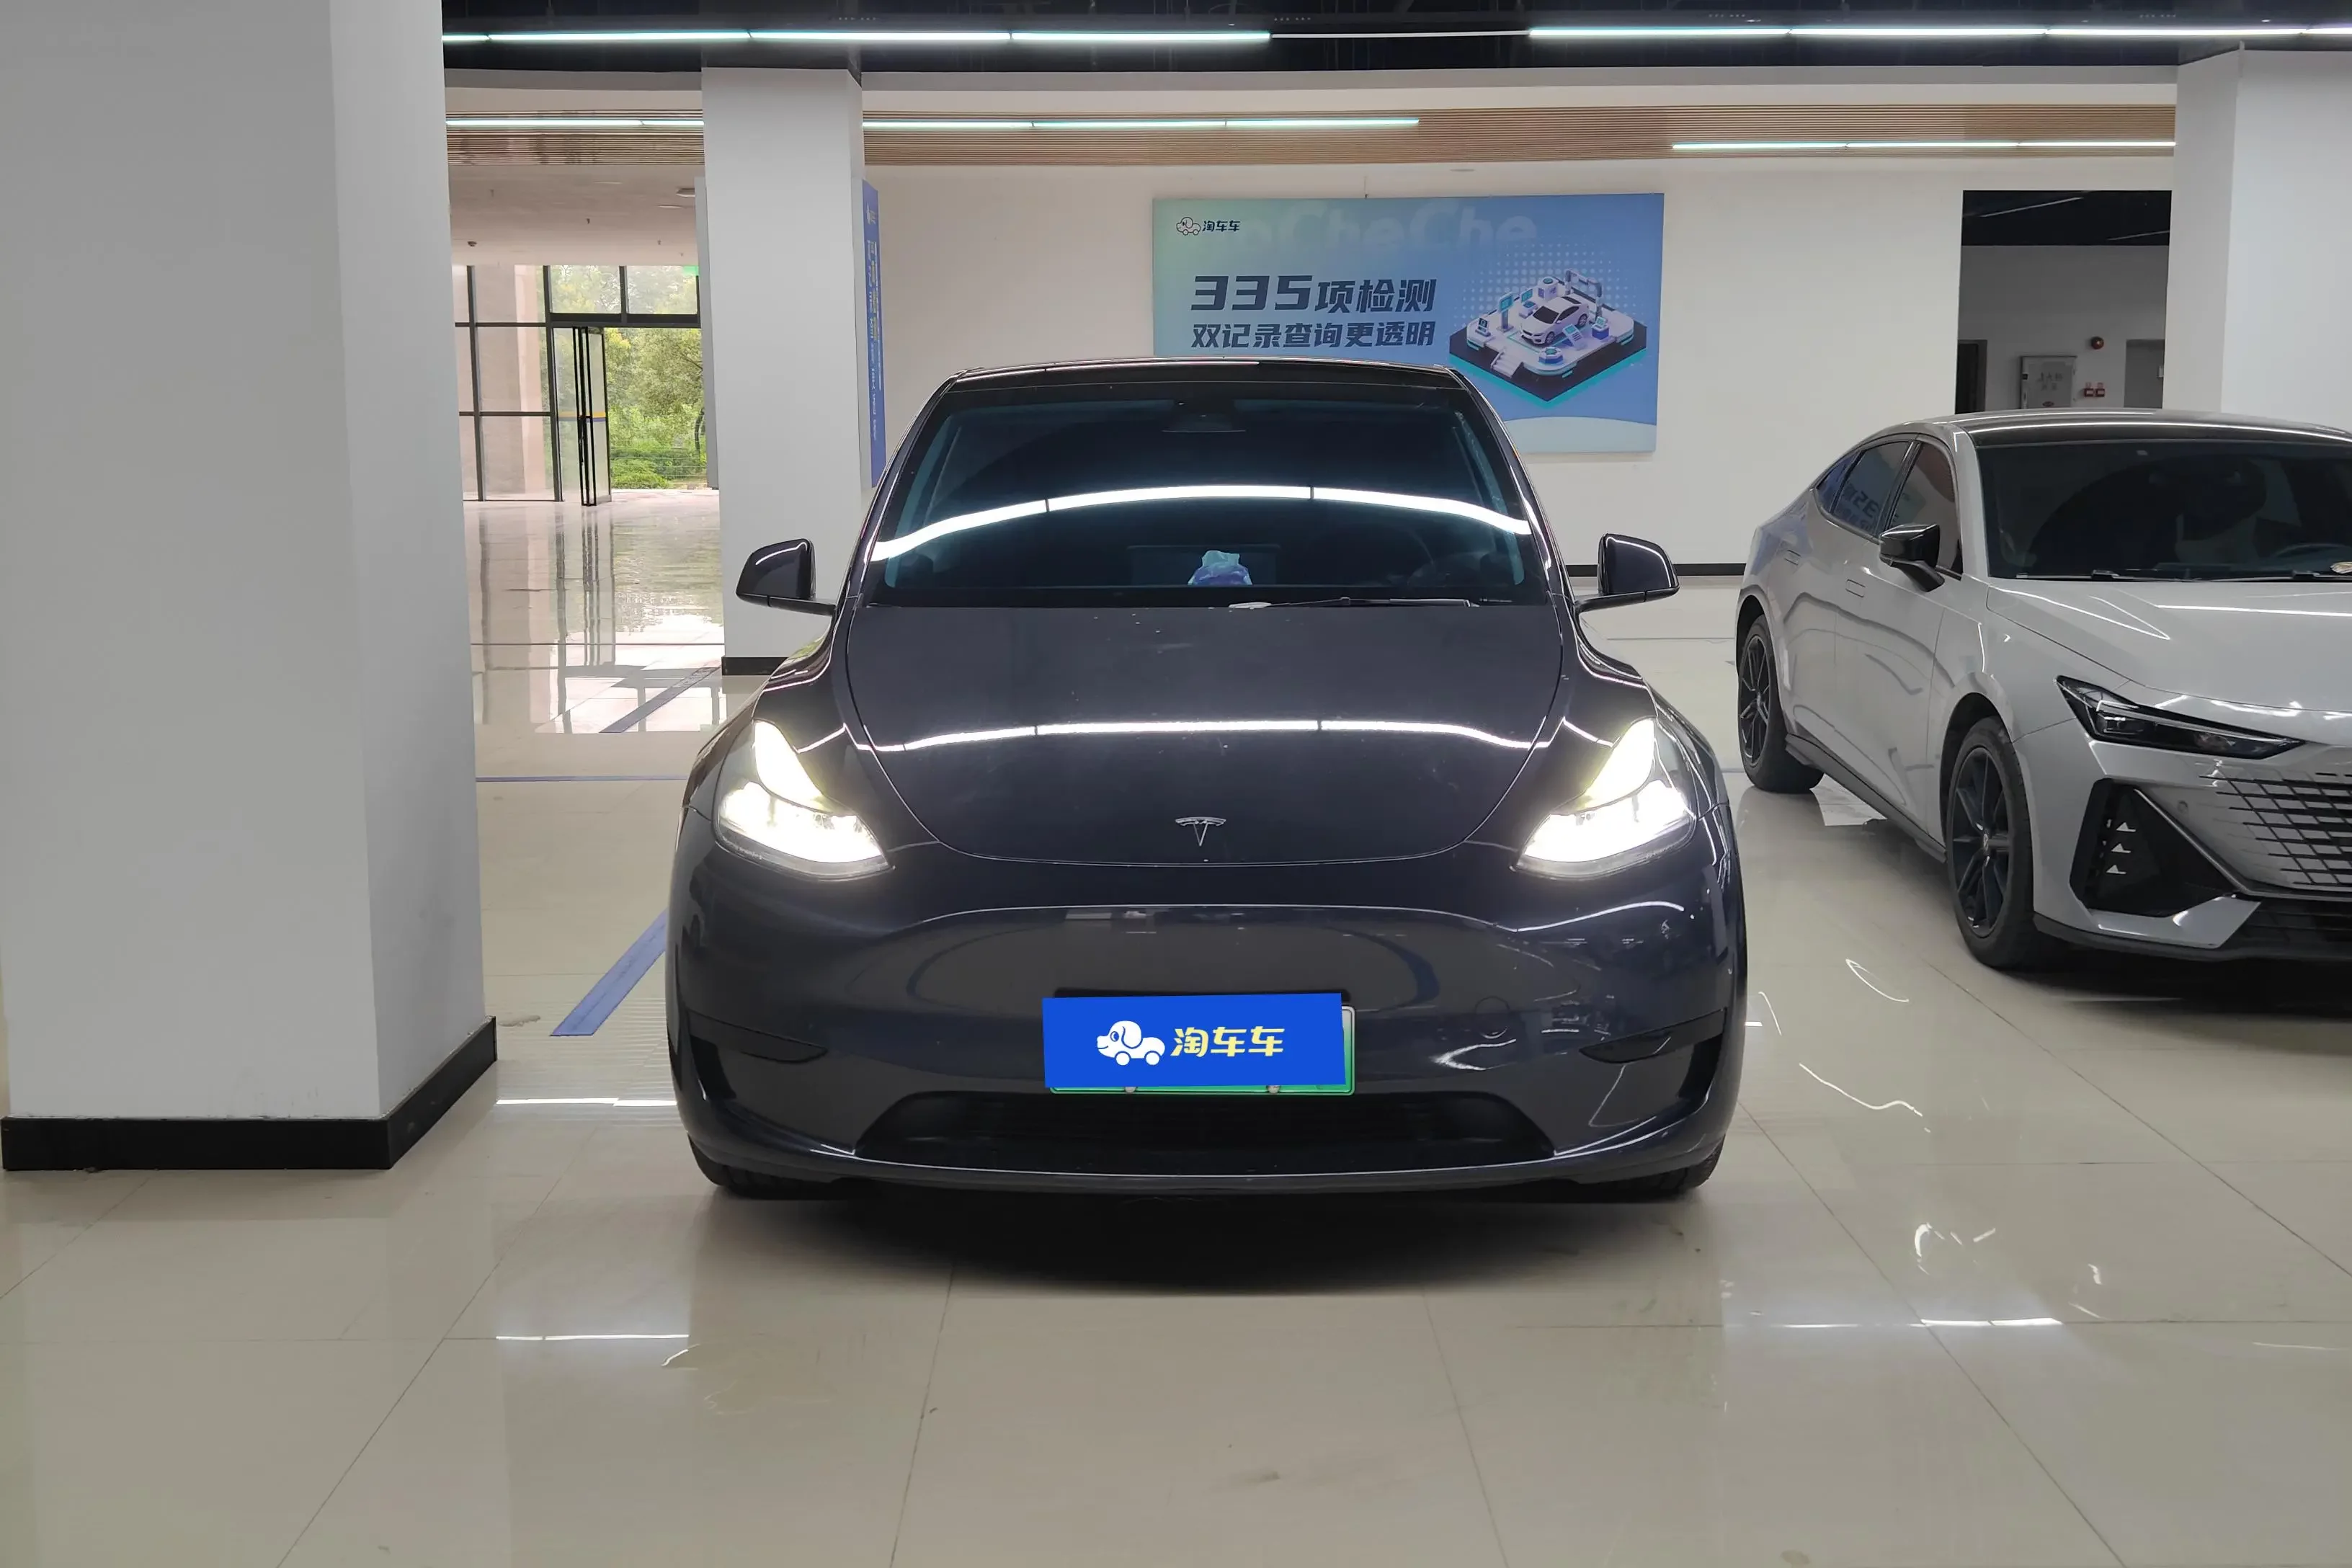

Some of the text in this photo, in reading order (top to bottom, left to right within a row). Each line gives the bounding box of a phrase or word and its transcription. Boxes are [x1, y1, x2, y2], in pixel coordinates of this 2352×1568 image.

[1202, 220, 1241, 232] 淘车车
[1190, 275, 1437, 313] 335项检测
[1190, 321, 1435, 349] 双记录查询更透明
